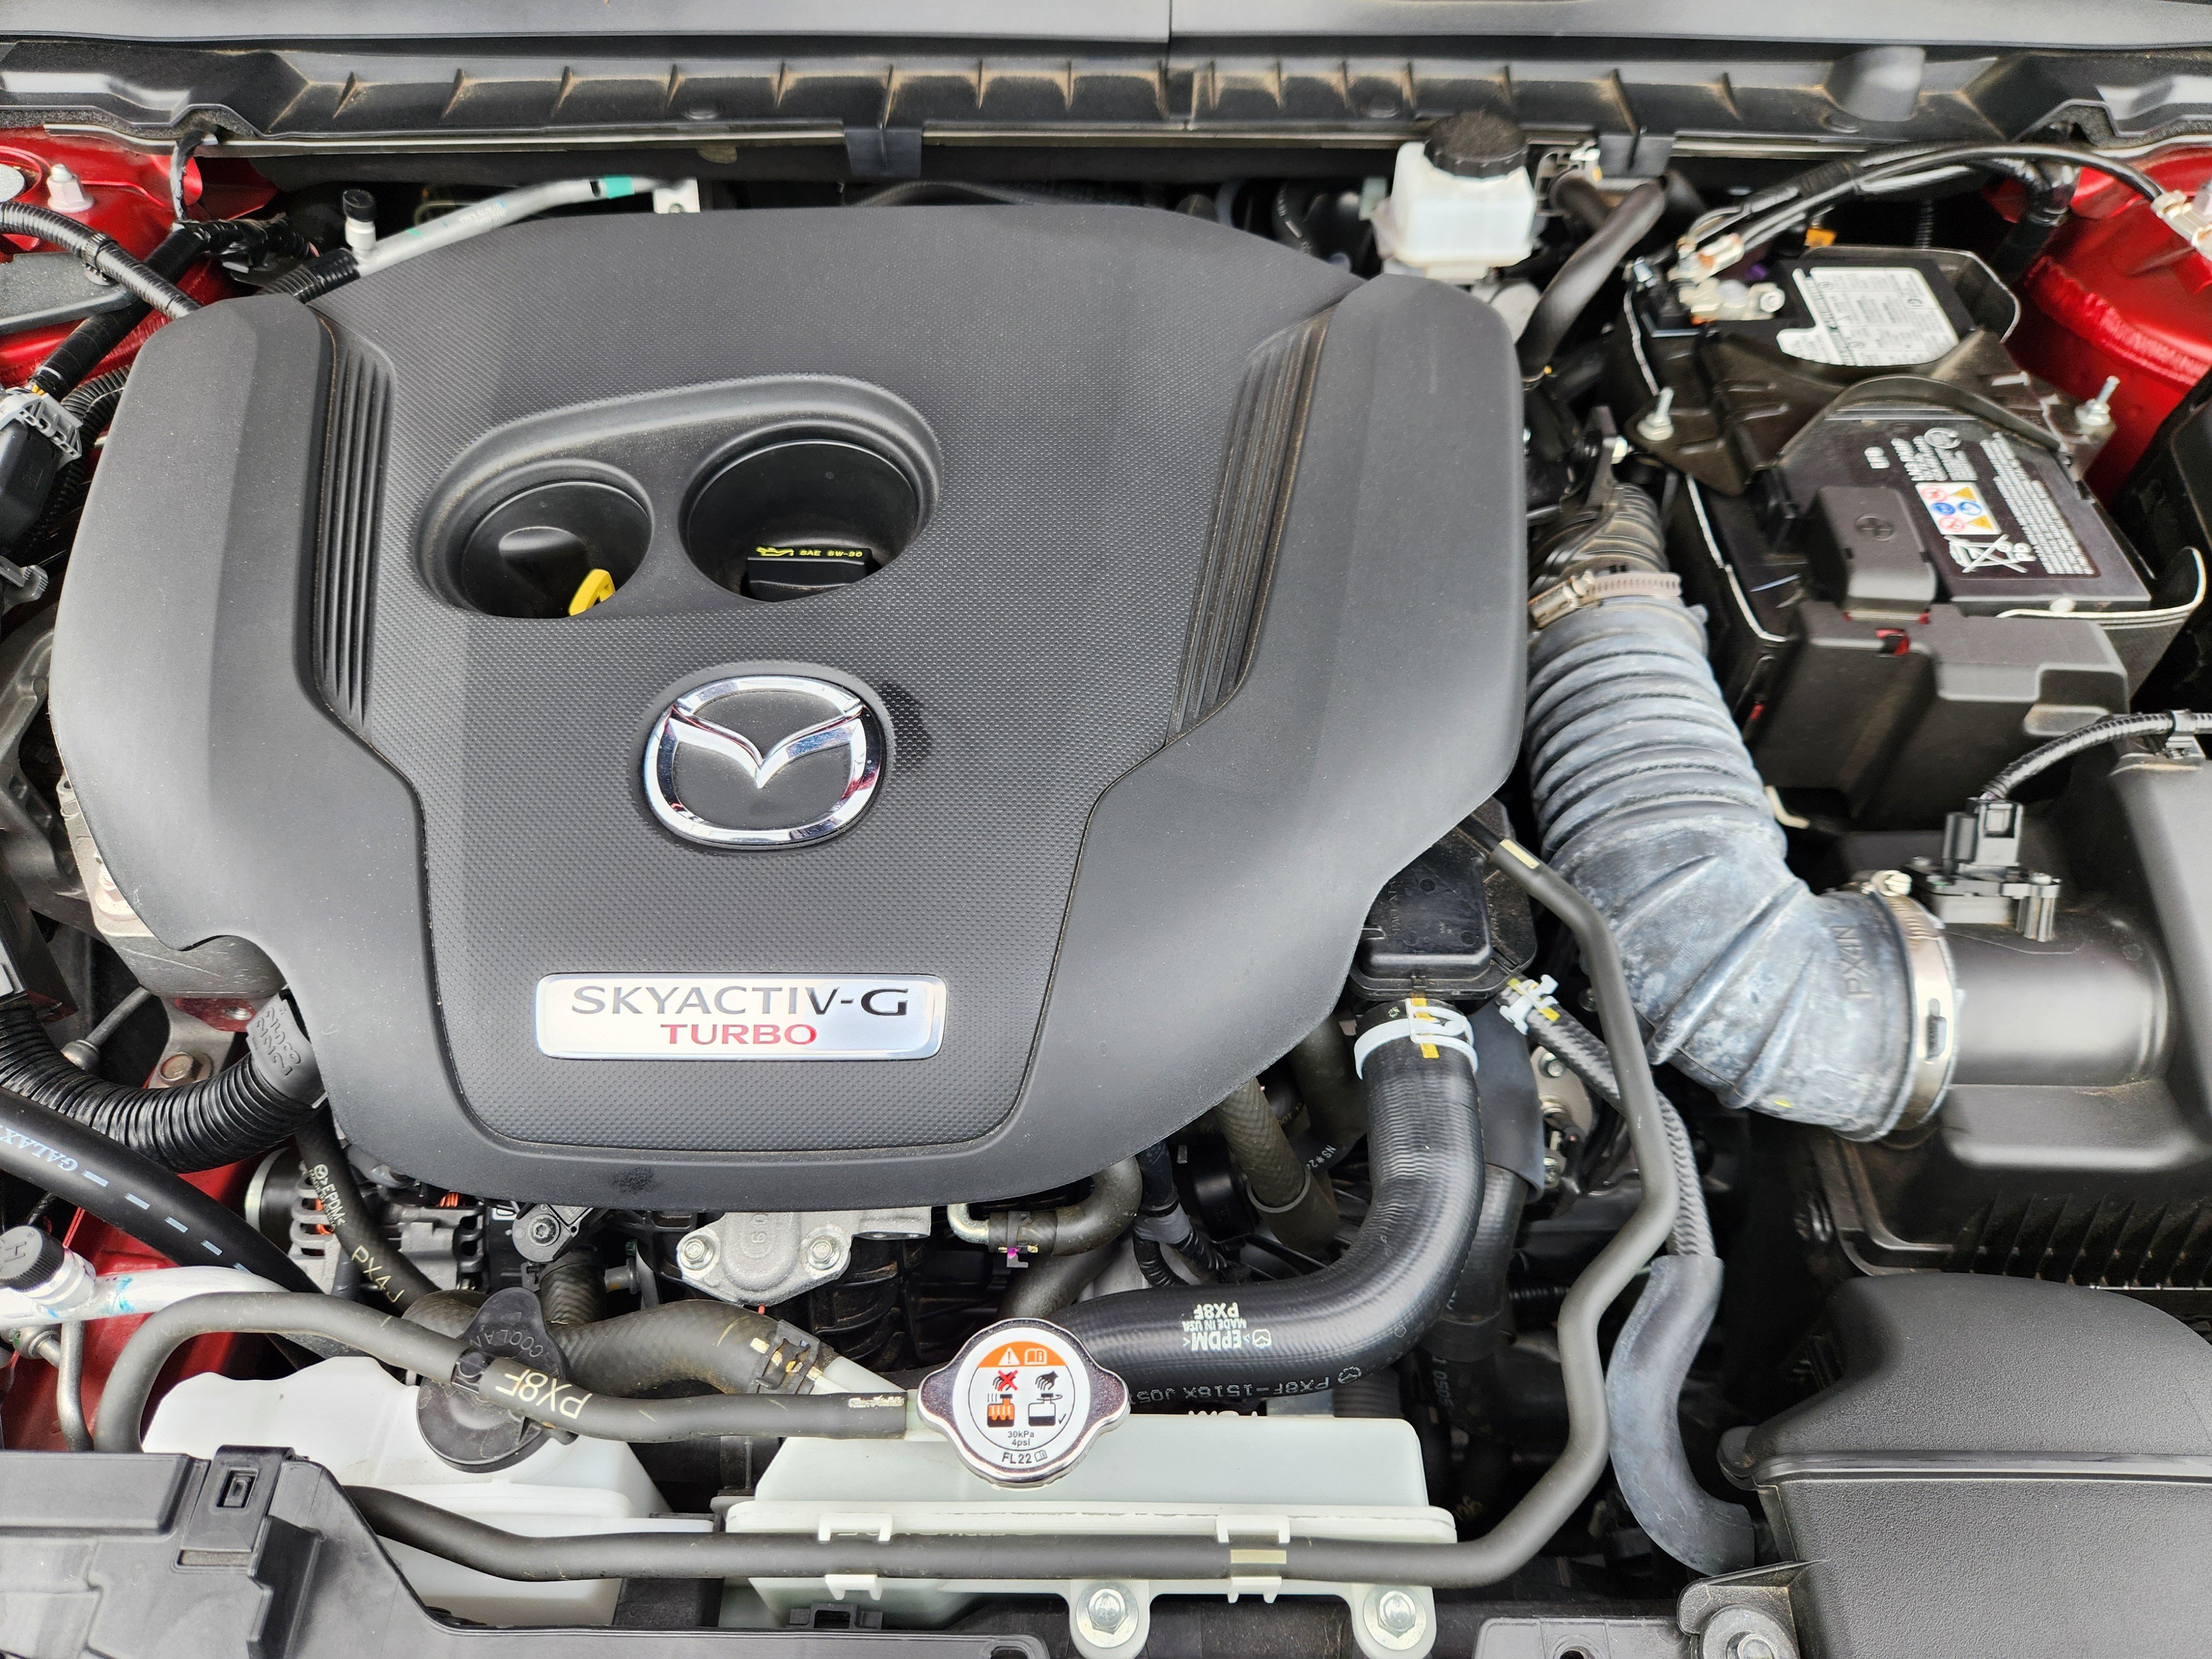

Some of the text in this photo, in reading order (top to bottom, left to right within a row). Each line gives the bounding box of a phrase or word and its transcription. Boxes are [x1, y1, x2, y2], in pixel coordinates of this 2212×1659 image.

[827, 549, 863, 557] 5W-30
[1829, 925, 1872, 998] PX4N
[571, 986, 909, 1016] SKYACTIV-G
[660, 1024, 817, 1045] TURBO
[0, 1125, 78, 1171] GALAX
[351, 1245, 405, 1303] PX4J
[1194, 1302, 1239, 1320] PX8F
[1181, 1318, 1248, 1333] MADE IN USA
[469, 1329, 544, 1358] COOLAN
[495, 1369, 593, 1420] PX8F
[1011, 1439, 1030, 1448] 4psi
[1001, 1452, 1032, 1464] FL22
